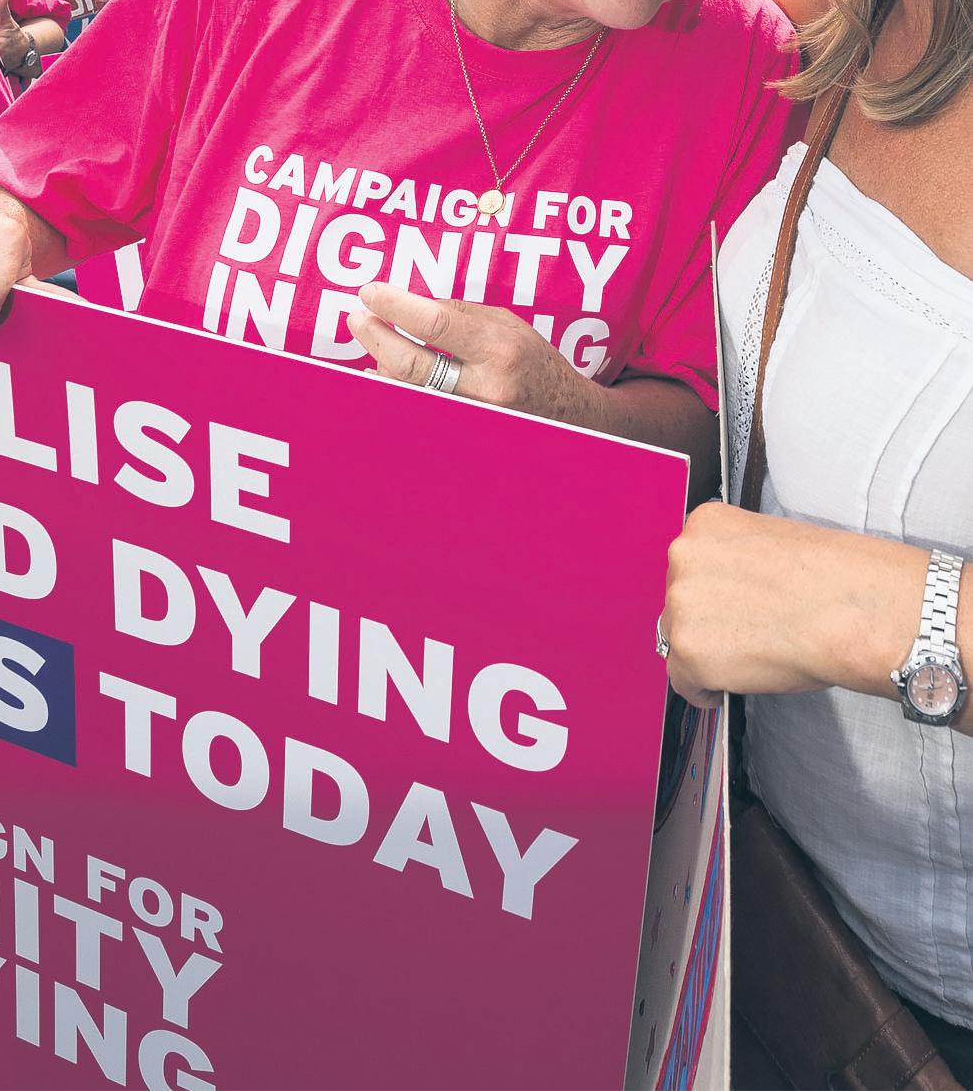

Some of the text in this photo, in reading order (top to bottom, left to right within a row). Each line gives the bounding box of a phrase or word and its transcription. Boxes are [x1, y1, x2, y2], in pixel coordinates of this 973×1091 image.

[218, 185, 631, 314] DIGNITY
[244, 144, 634, 240] CAMPAIGN FOR
[202, 260, 298, 351] IN
[111, 537, 569, 772] DYING
[99, 673, 579, 922] TODAY
[87, 852, 225, 955] FOR
